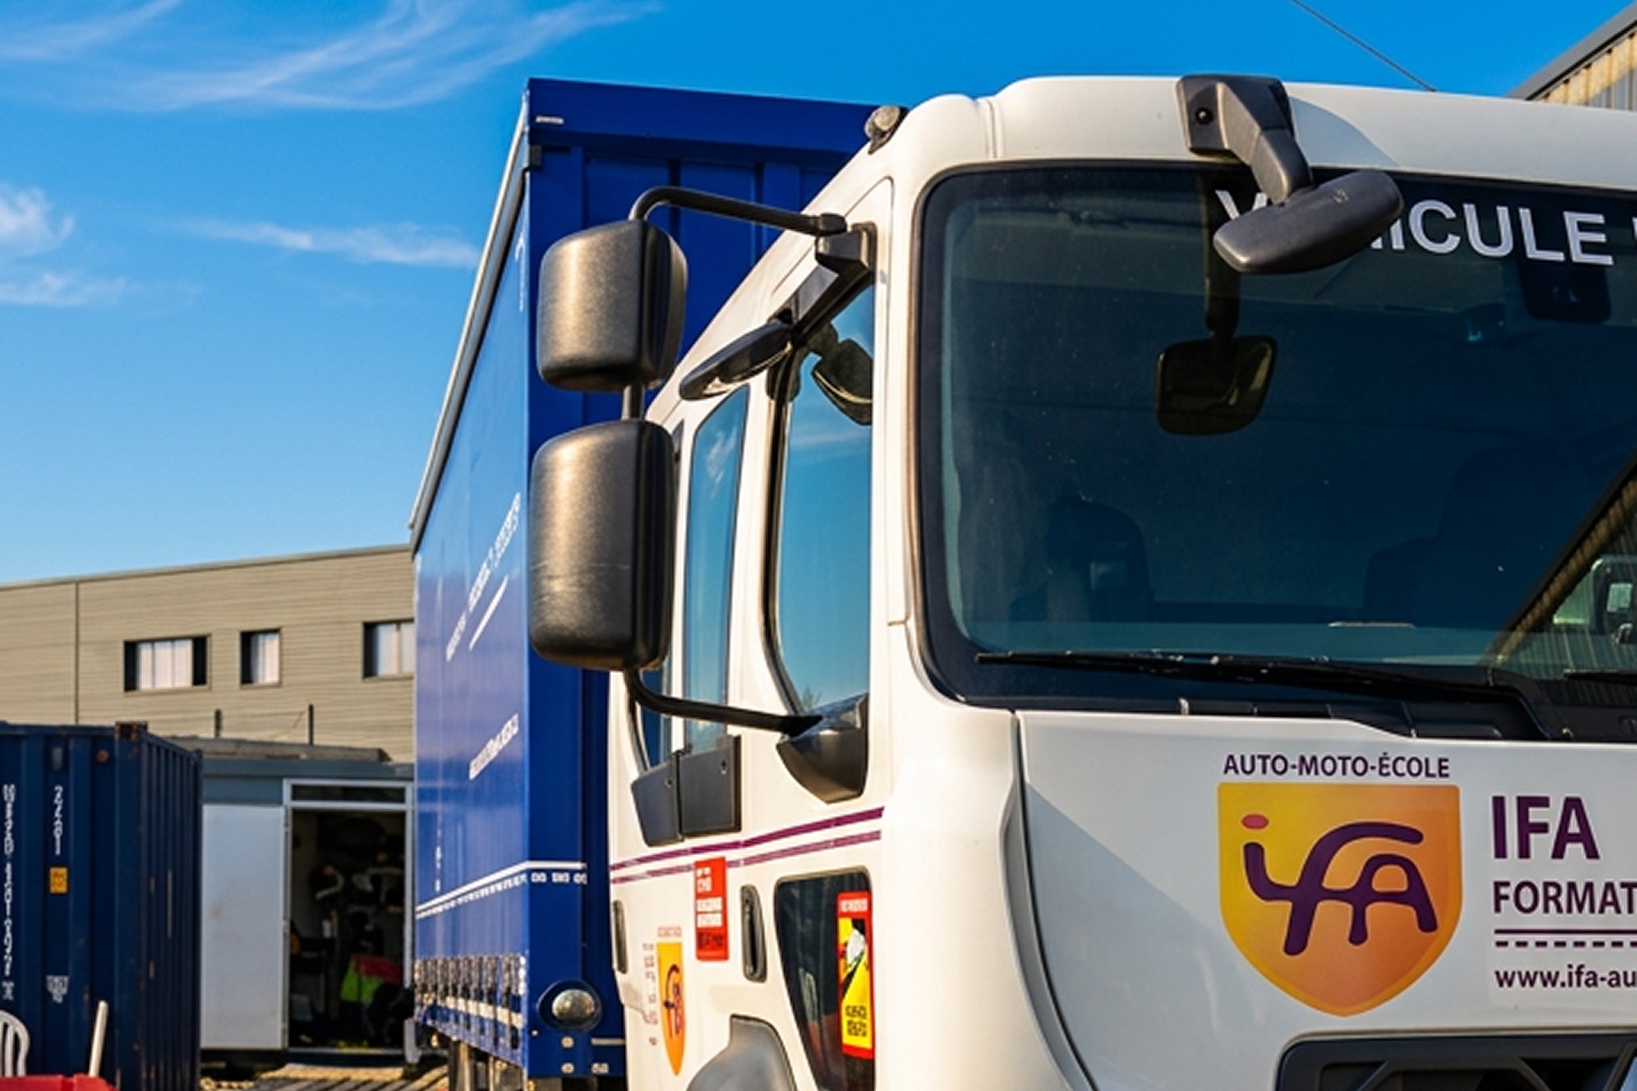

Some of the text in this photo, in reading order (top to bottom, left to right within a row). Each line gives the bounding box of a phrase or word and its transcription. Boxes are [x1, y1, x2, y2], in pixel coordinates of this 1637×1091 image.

[1223, 752, 1450, 778] AUTO-MOTO-ÉCOLE
[1492, 795, 1600, 860] IFA
[1493, 880, 1637, 915] FORMAT
[1494, 963, 1637, 988] www.ifa-au
